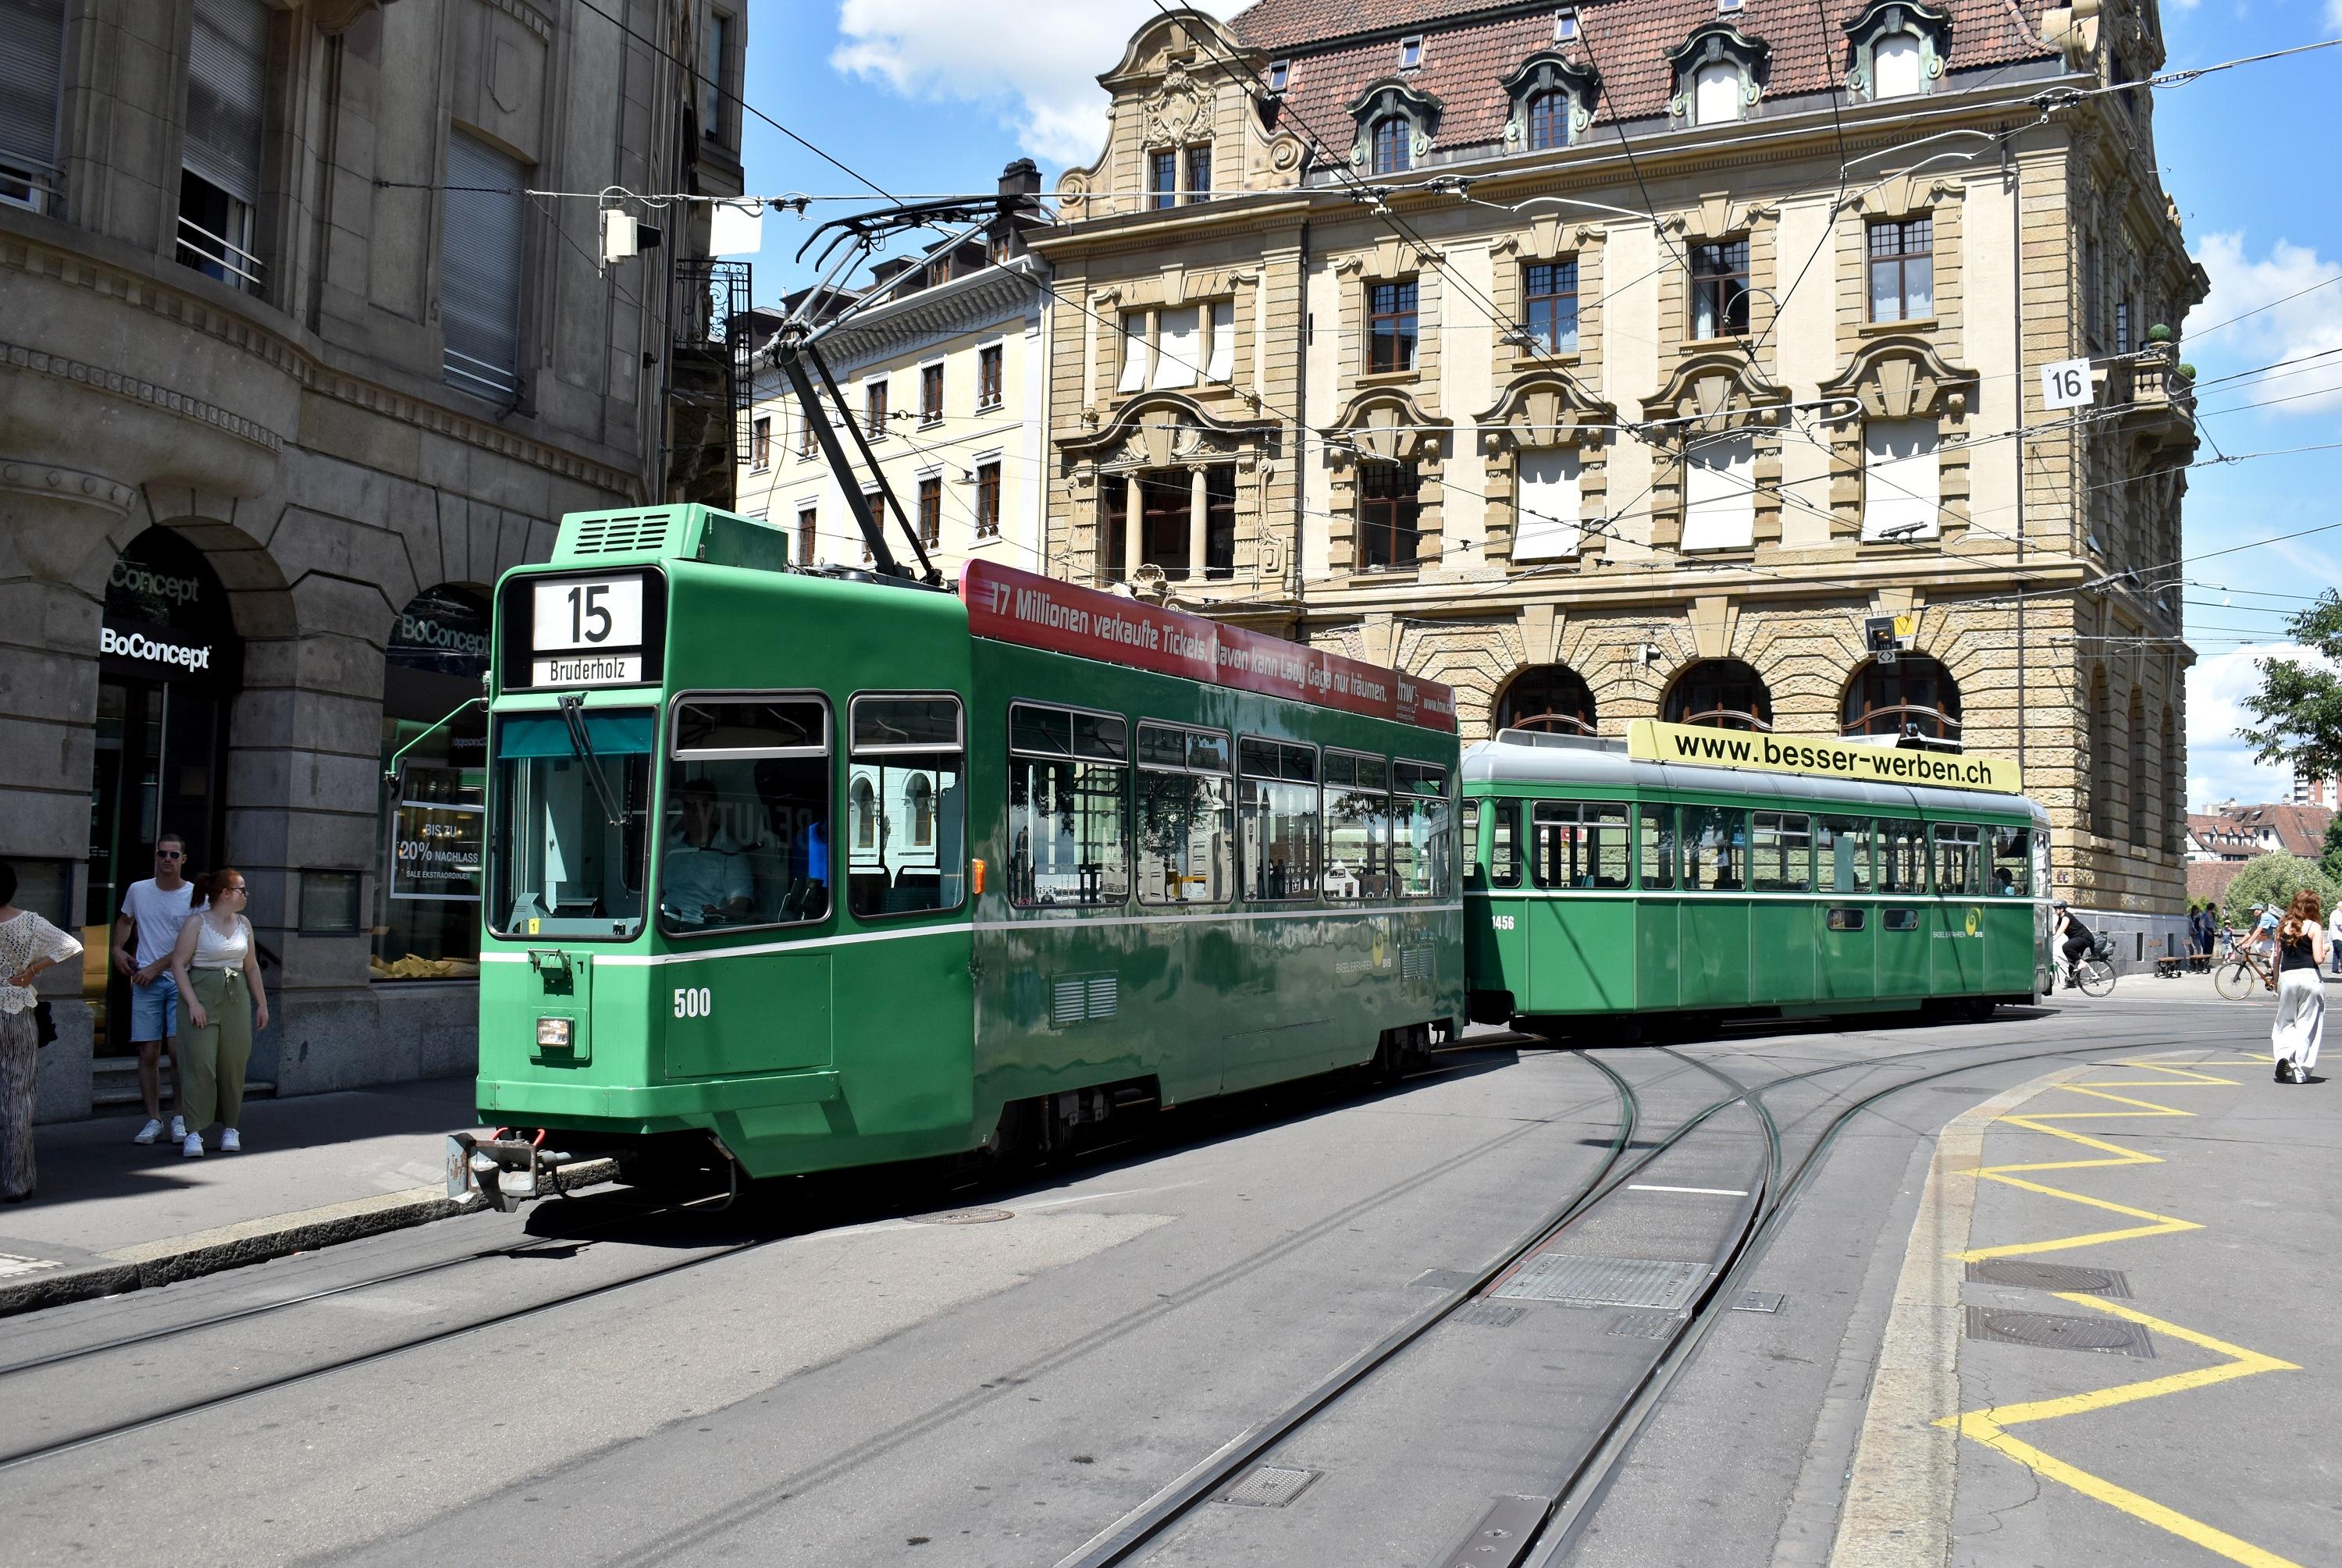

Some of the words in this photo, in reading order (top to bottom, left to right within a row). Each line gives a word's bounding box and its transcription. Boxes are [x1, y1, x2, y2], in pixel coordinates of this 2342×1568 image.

[2052, 369, 2082, 400] 16
[568, 585, 613, 644] 15
[100, 627, 210, 673] BoConcept
[401, 613, 491, 659] BoConcept
[991, 581, 1011, 616] 17
[1015, 587, 1089, 635] Millionen
[1093, 612, 1159, 650] verkaufte
[1163, 624, 1208, 662] Tickets.
[1212, 638, 1249, 671] Davon
[1251, 646, 1278, 677] kann
[1280, 654, 1305, 689] Lady
[1308, 661, 1332, 695] Gaga
[1334, 673, 1350, 694] nur
[1351, 671, 1387, 702] träumen.
[550, 656, 625, 681] Bruderholz
[1674, 734, 1992, 784] www.besser-werben.ch
[425, 823, 442, 837] BIS
[443, 825, 458, 838] ZU
[400, 841, 432, 862] 20%
[435, 851, 479, 863] NACHLASS
[422, 871, 471, 880] EKSTRAORDINÆR
[1492, 915, 1514, 930] 1456
[1336, 962, 1351, 973] BASEL
[1351, 960, 1373, 972] ERFAHREN
[1383, 958, 1392, 969] BVB
[674, 987, 711, 1019] 500
